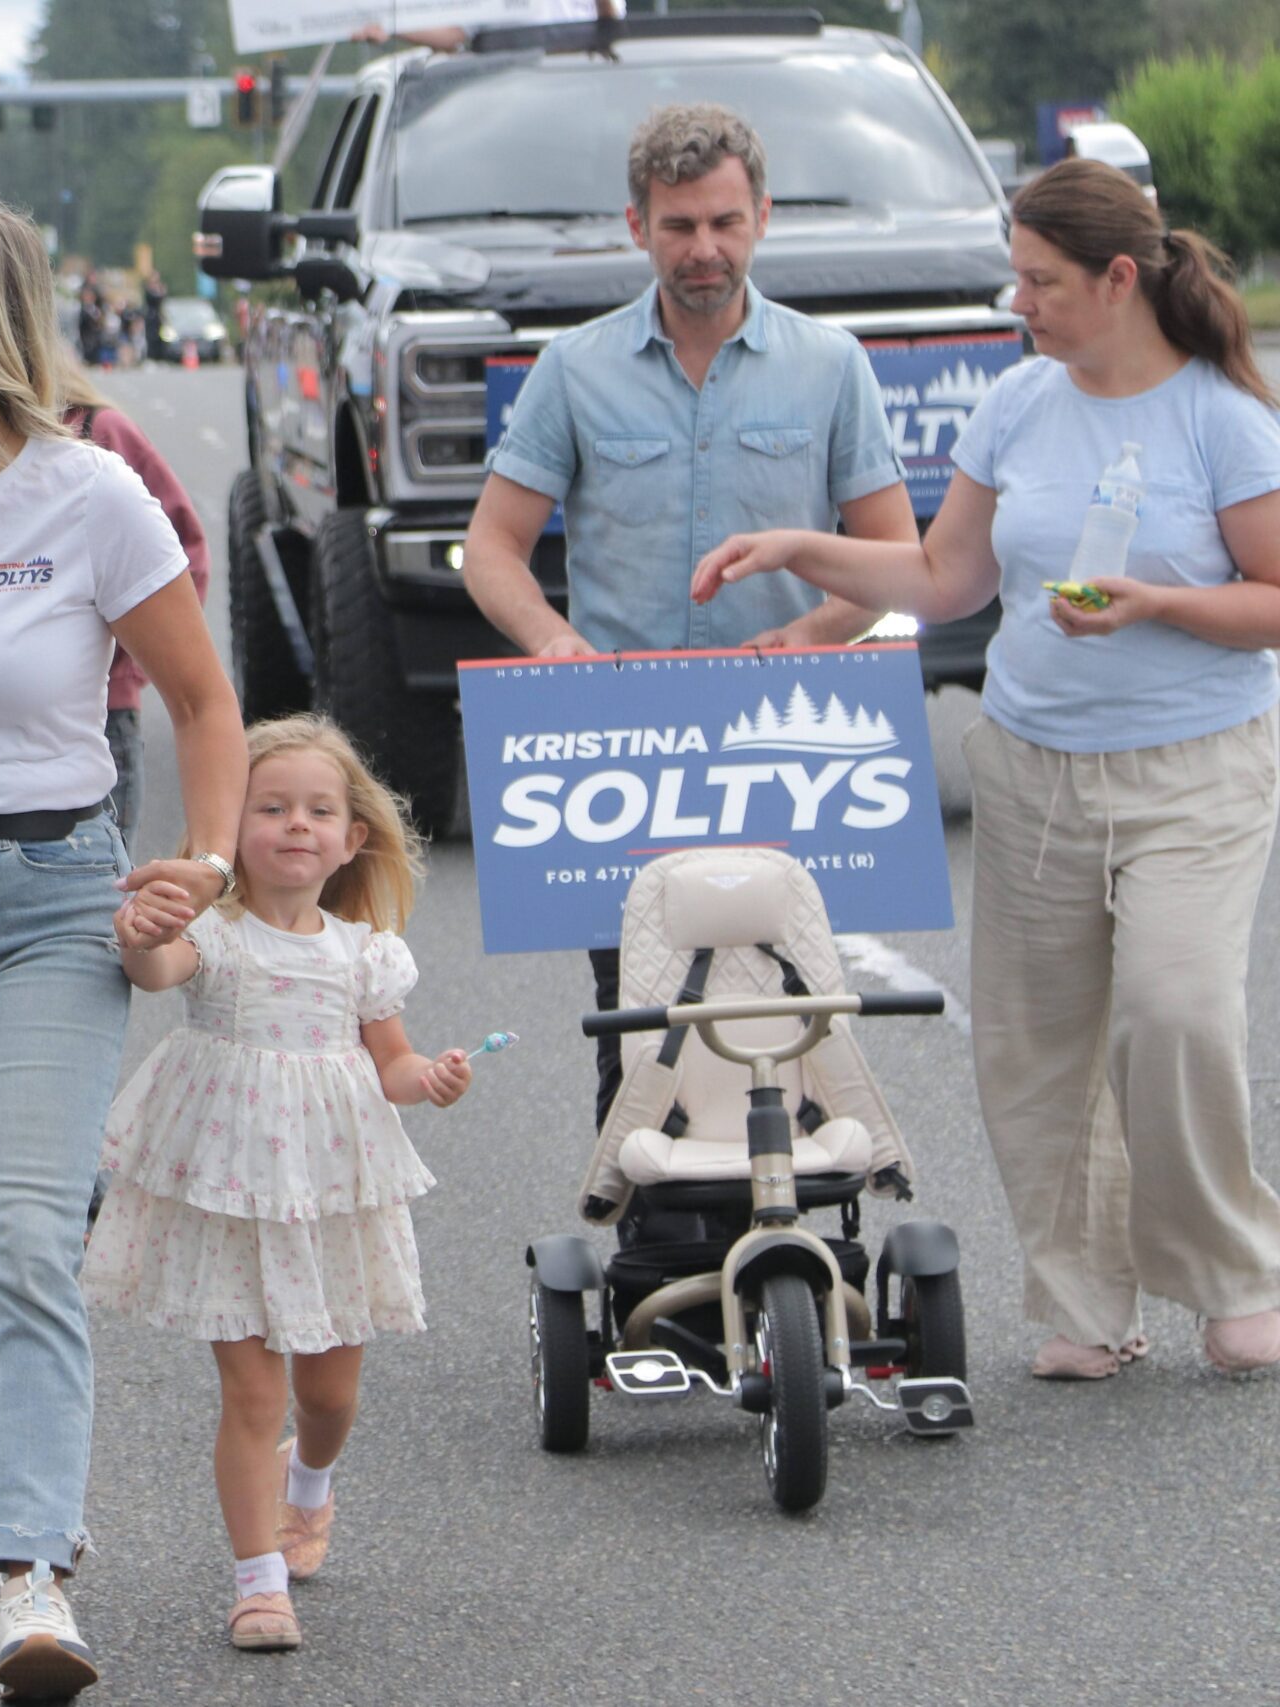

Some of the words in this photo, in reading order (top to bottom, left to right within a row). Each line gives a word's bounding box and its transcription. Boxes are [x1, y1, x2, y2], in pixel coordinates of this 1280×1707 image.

[496, 666, 554, 678] HOME
[575, 664, 594, 674] IS
[613, 660, 689, 673] WORTH
[708, 655, 820, 668] FIGHTING
[839, 653, 879, 663] FOR
[501, 725, 709, 763] KRISTINA
[492, 757, 912, 848] SOLTYS
[546, 869, 587, 884] FOR
[848, 852, 875, 869] (R)
